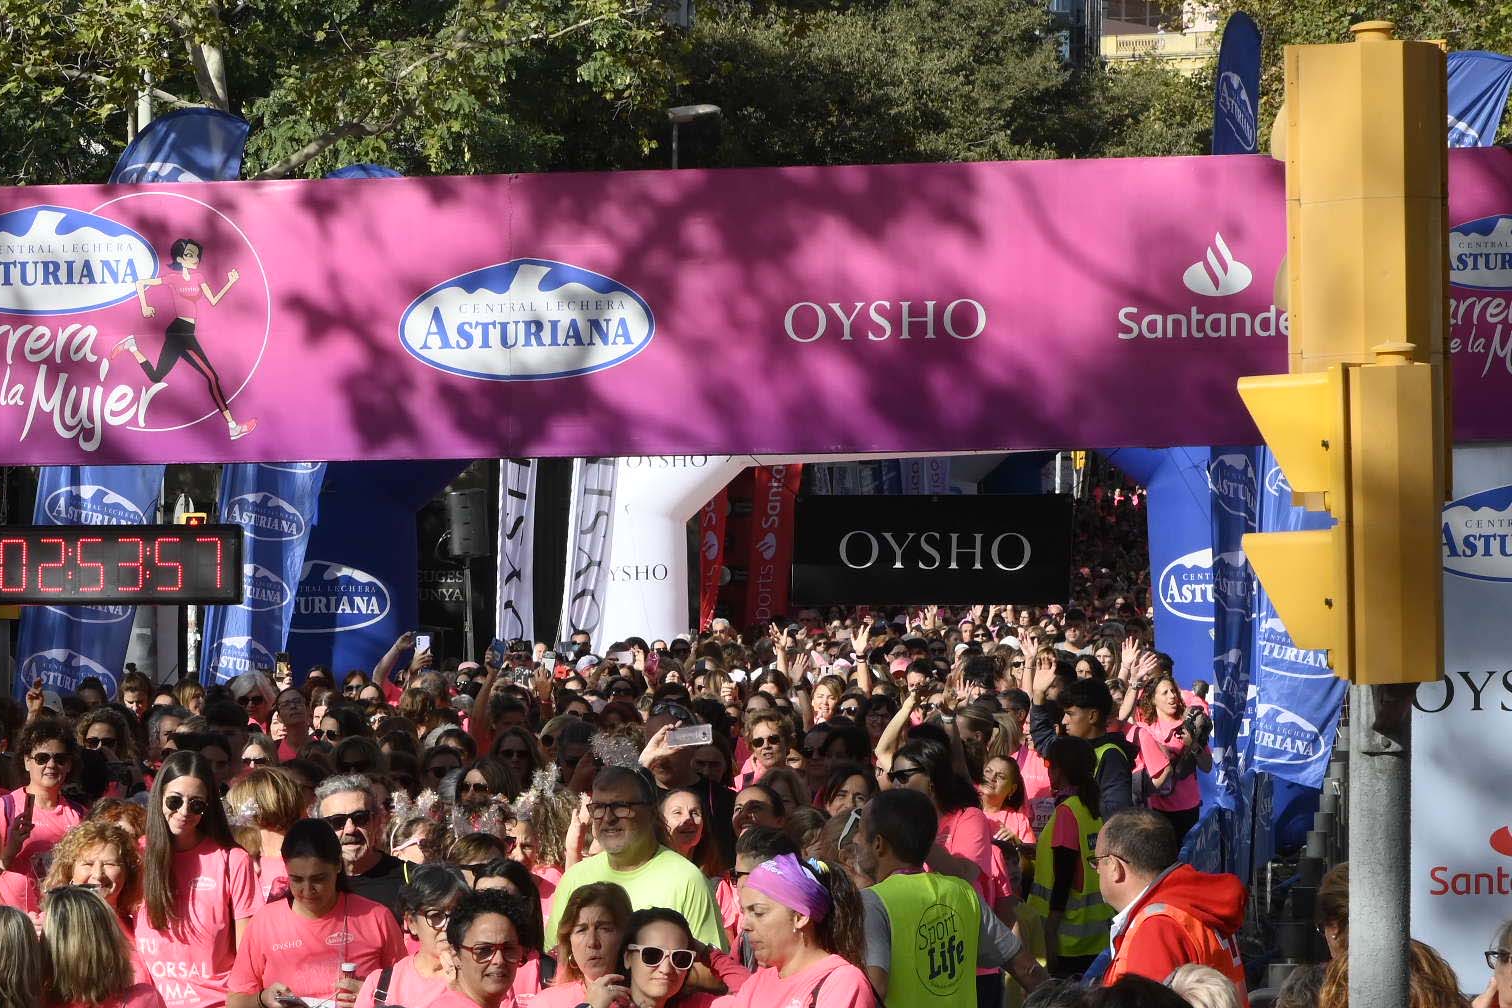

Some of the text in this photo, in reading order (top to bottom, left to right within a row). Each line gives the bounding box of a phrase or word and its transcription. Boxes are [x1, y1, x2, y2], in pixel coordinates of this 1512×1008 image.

[61, 241, 136, 254] LECHERA
[458, 298, 628, 314] CENTRAL LECHERA
[784, 299, 987, 343] OYSHO
[419, 305, 635, 351] ASTURIANA
[1118, 304, 1289, 341] Santande
[1467, 325, 1486, 353] la
[0, 364, 25, 407] la
[19, 357, 169, 453] Mujer
[761, 464, 786, 529] Santa
[569, 457, 616, 633] OYSH
[839, 530, 1032, 572] OYSHO
[0, 537, 222, 593] 02:53:57
[607, 563, 669, 582] YSHO
[1182, 572, 1214, 581] CENT
[294, 595, 381, 615] TURIANA
[1262, 640, 1330, 669] TURIAN
[1253, 730, 1314, 757] URIANA
[1430, 866, 1512, 897] Sant
[918, 911, 957, 950] Sport
[140, 937, 157, 955] TU
[272, 939, 303, 953] OYSHO
[928, 935, 965, 980] Life
[150, 961, 211, 980] ORSAL
